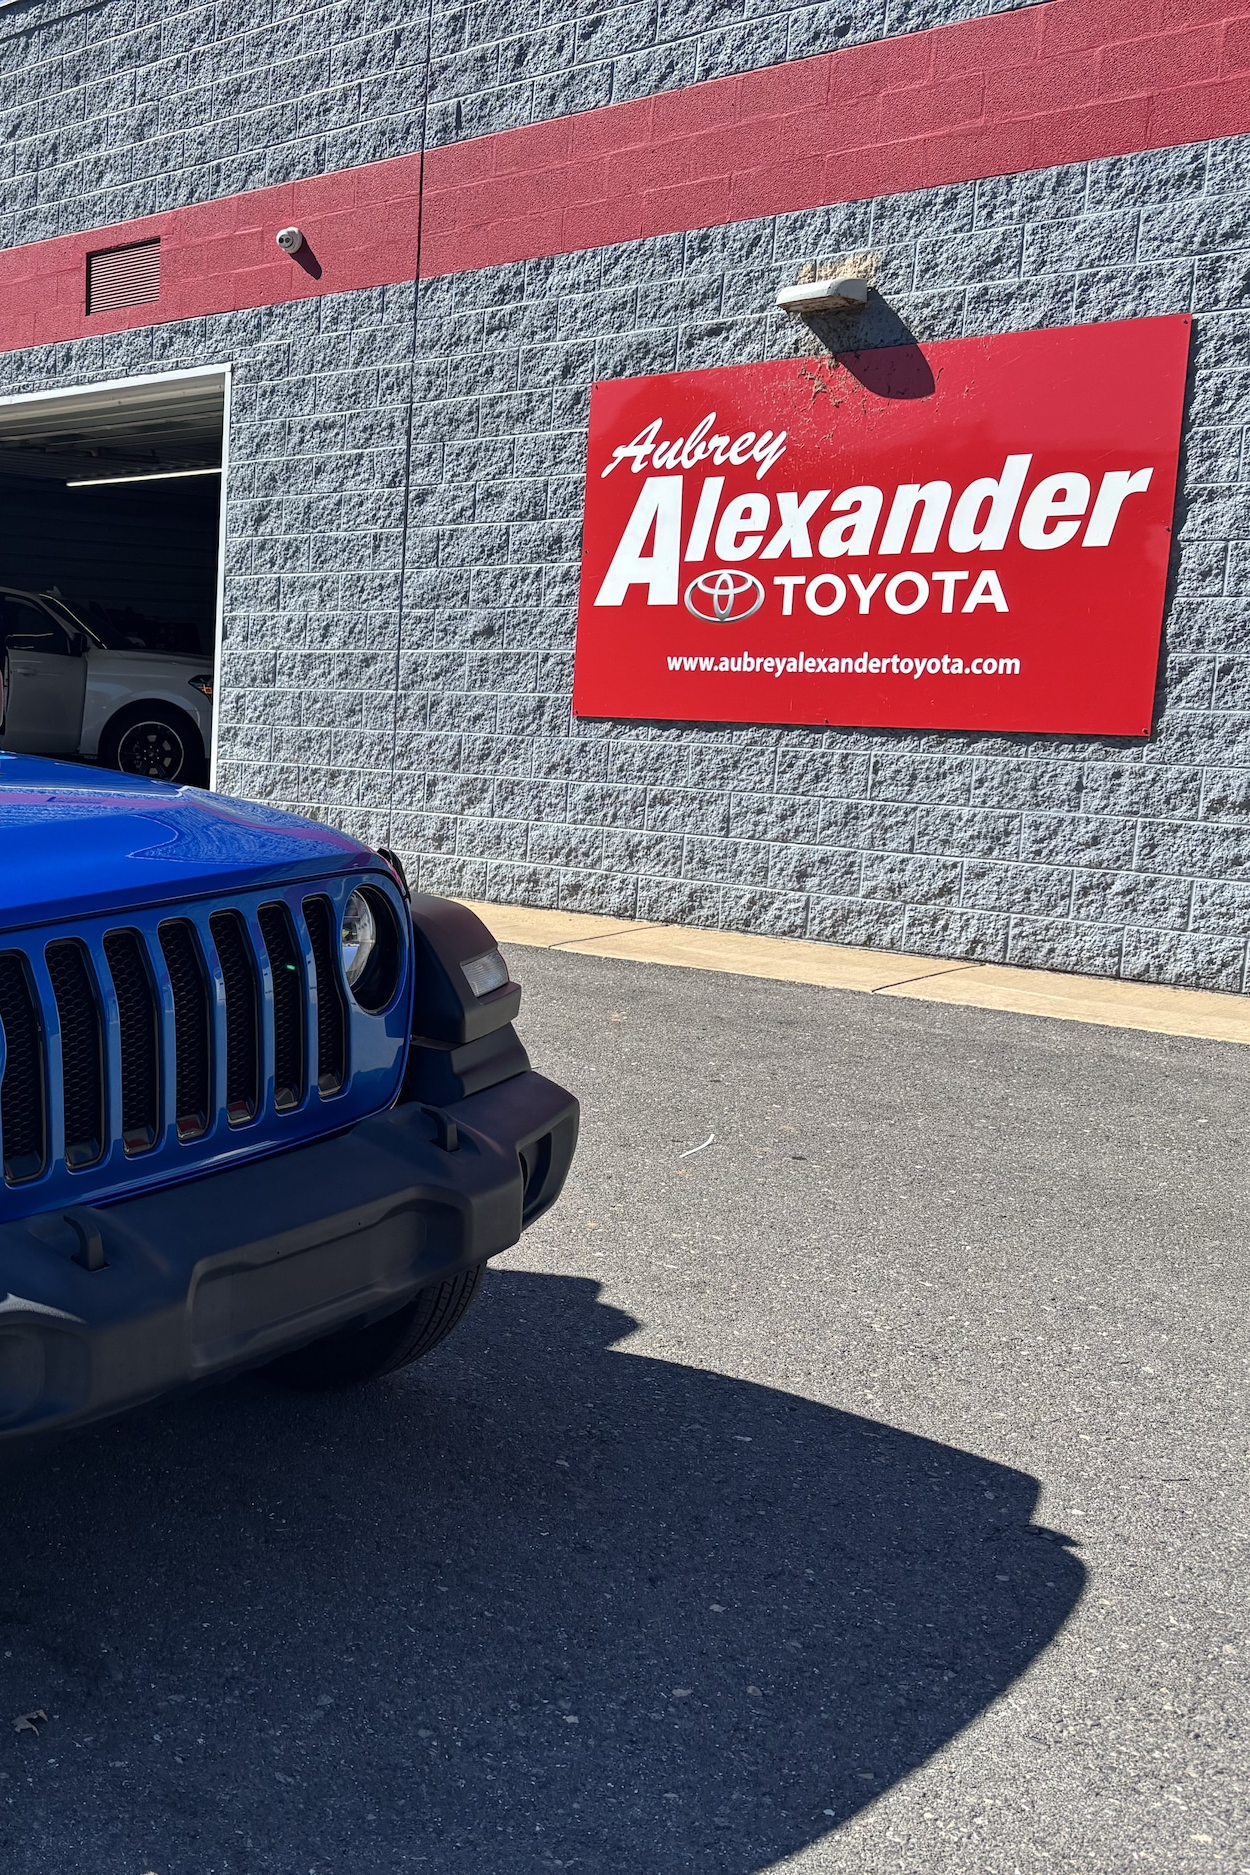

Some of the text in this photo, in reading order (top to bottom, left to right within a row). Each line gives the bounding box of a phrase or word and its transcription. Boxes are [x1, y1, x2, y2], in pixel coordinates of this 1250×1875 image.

[599, 411, 789, 481] Aubrey
[593, 452, 1155, 608] Alexander
[773, 569, 1010, 616] TOYOTA
[667, 650, 1022, 681] www.aubreyalexandertoyota.com
